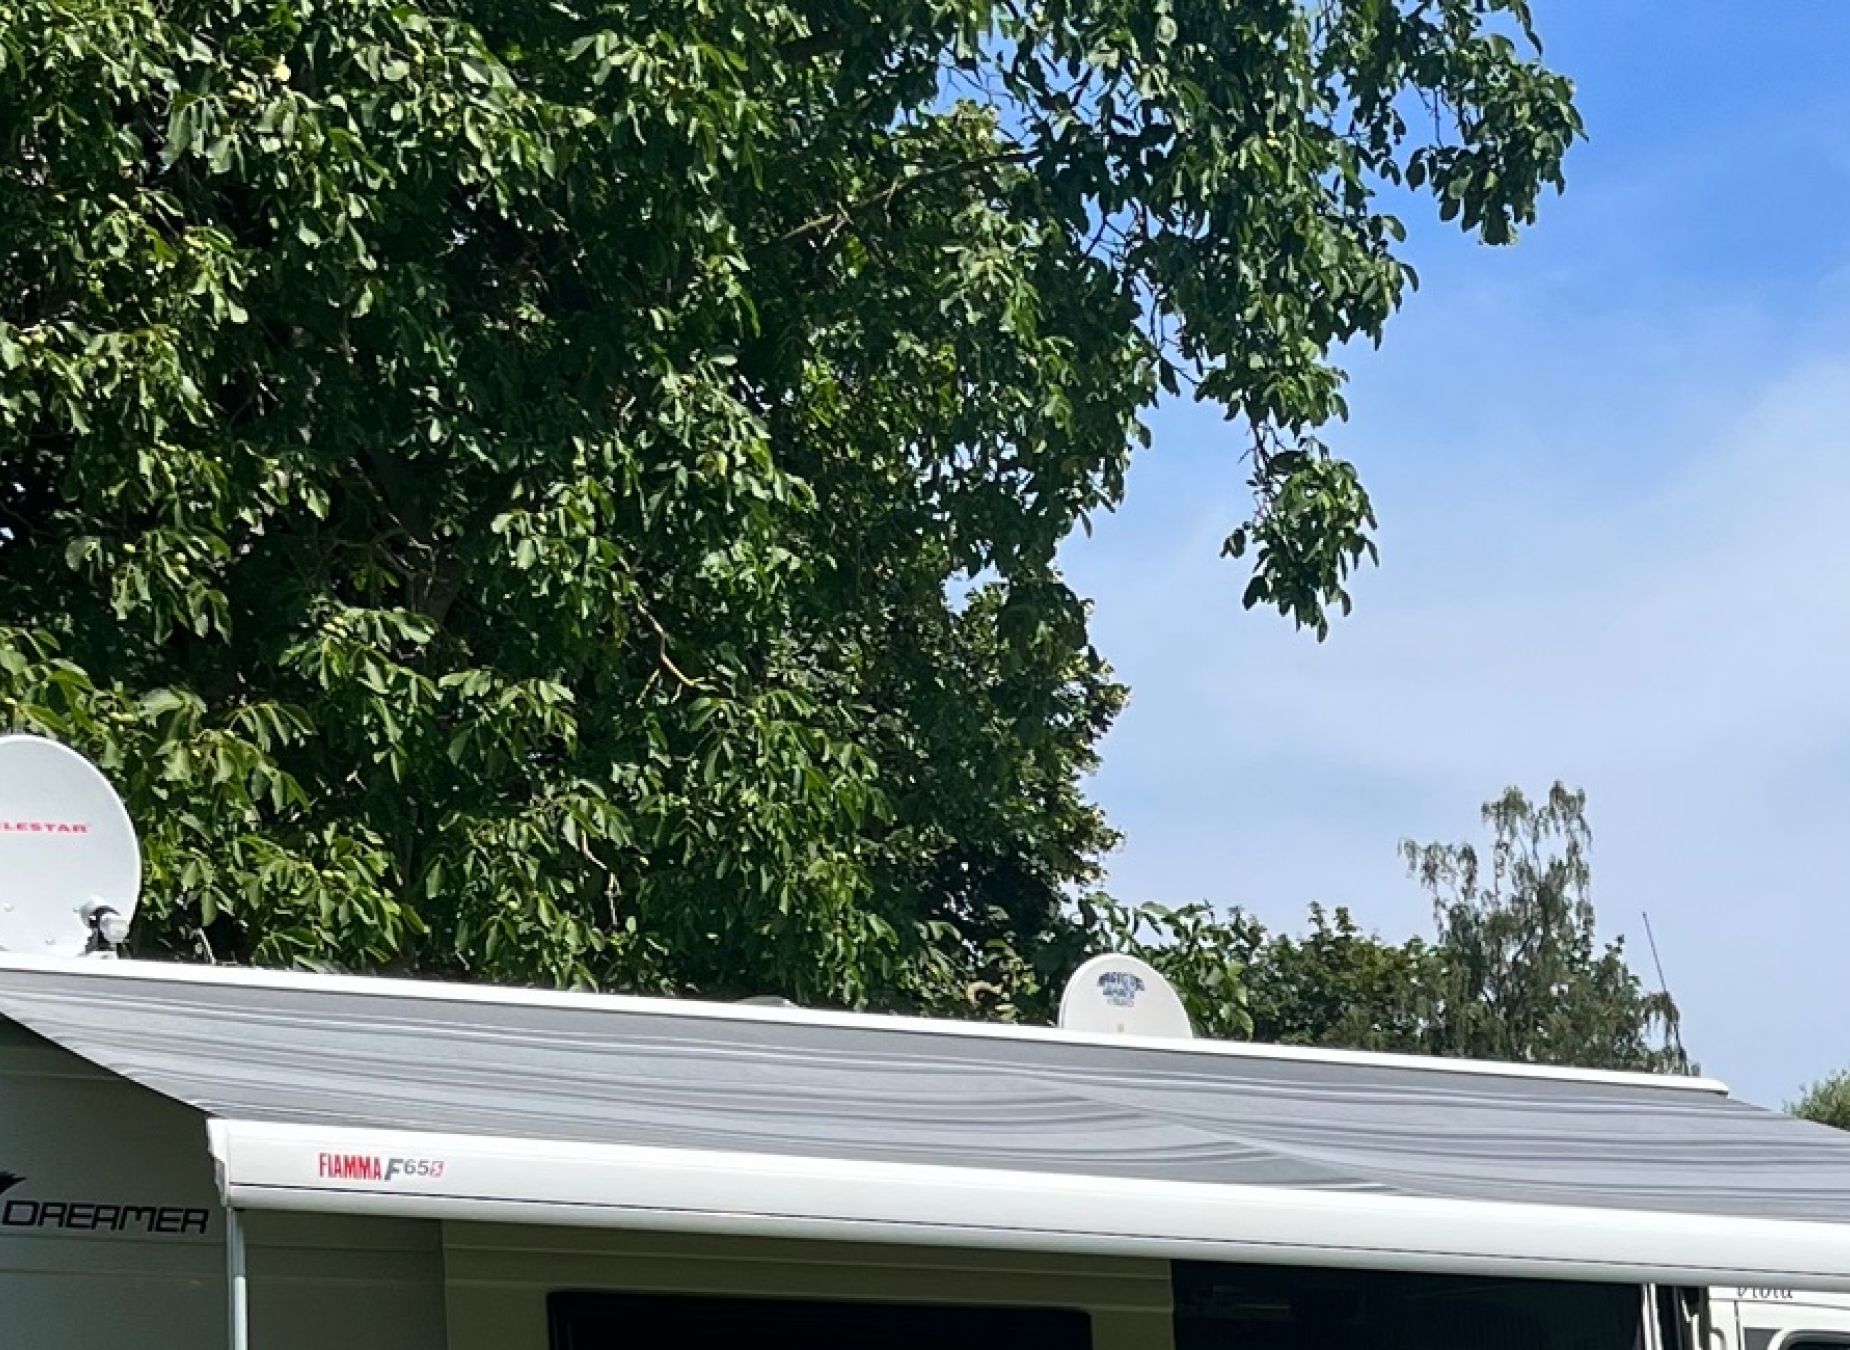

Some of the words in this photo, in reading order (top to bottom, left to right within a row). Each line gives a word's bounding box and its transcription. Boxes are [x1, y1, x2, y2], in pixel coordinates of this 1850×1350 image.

[0, 822, 87, 833] LESTAR
[318, 1153, 382, 1180] FIAMMA
[2, 1199, 209, 1234] DREAMER
